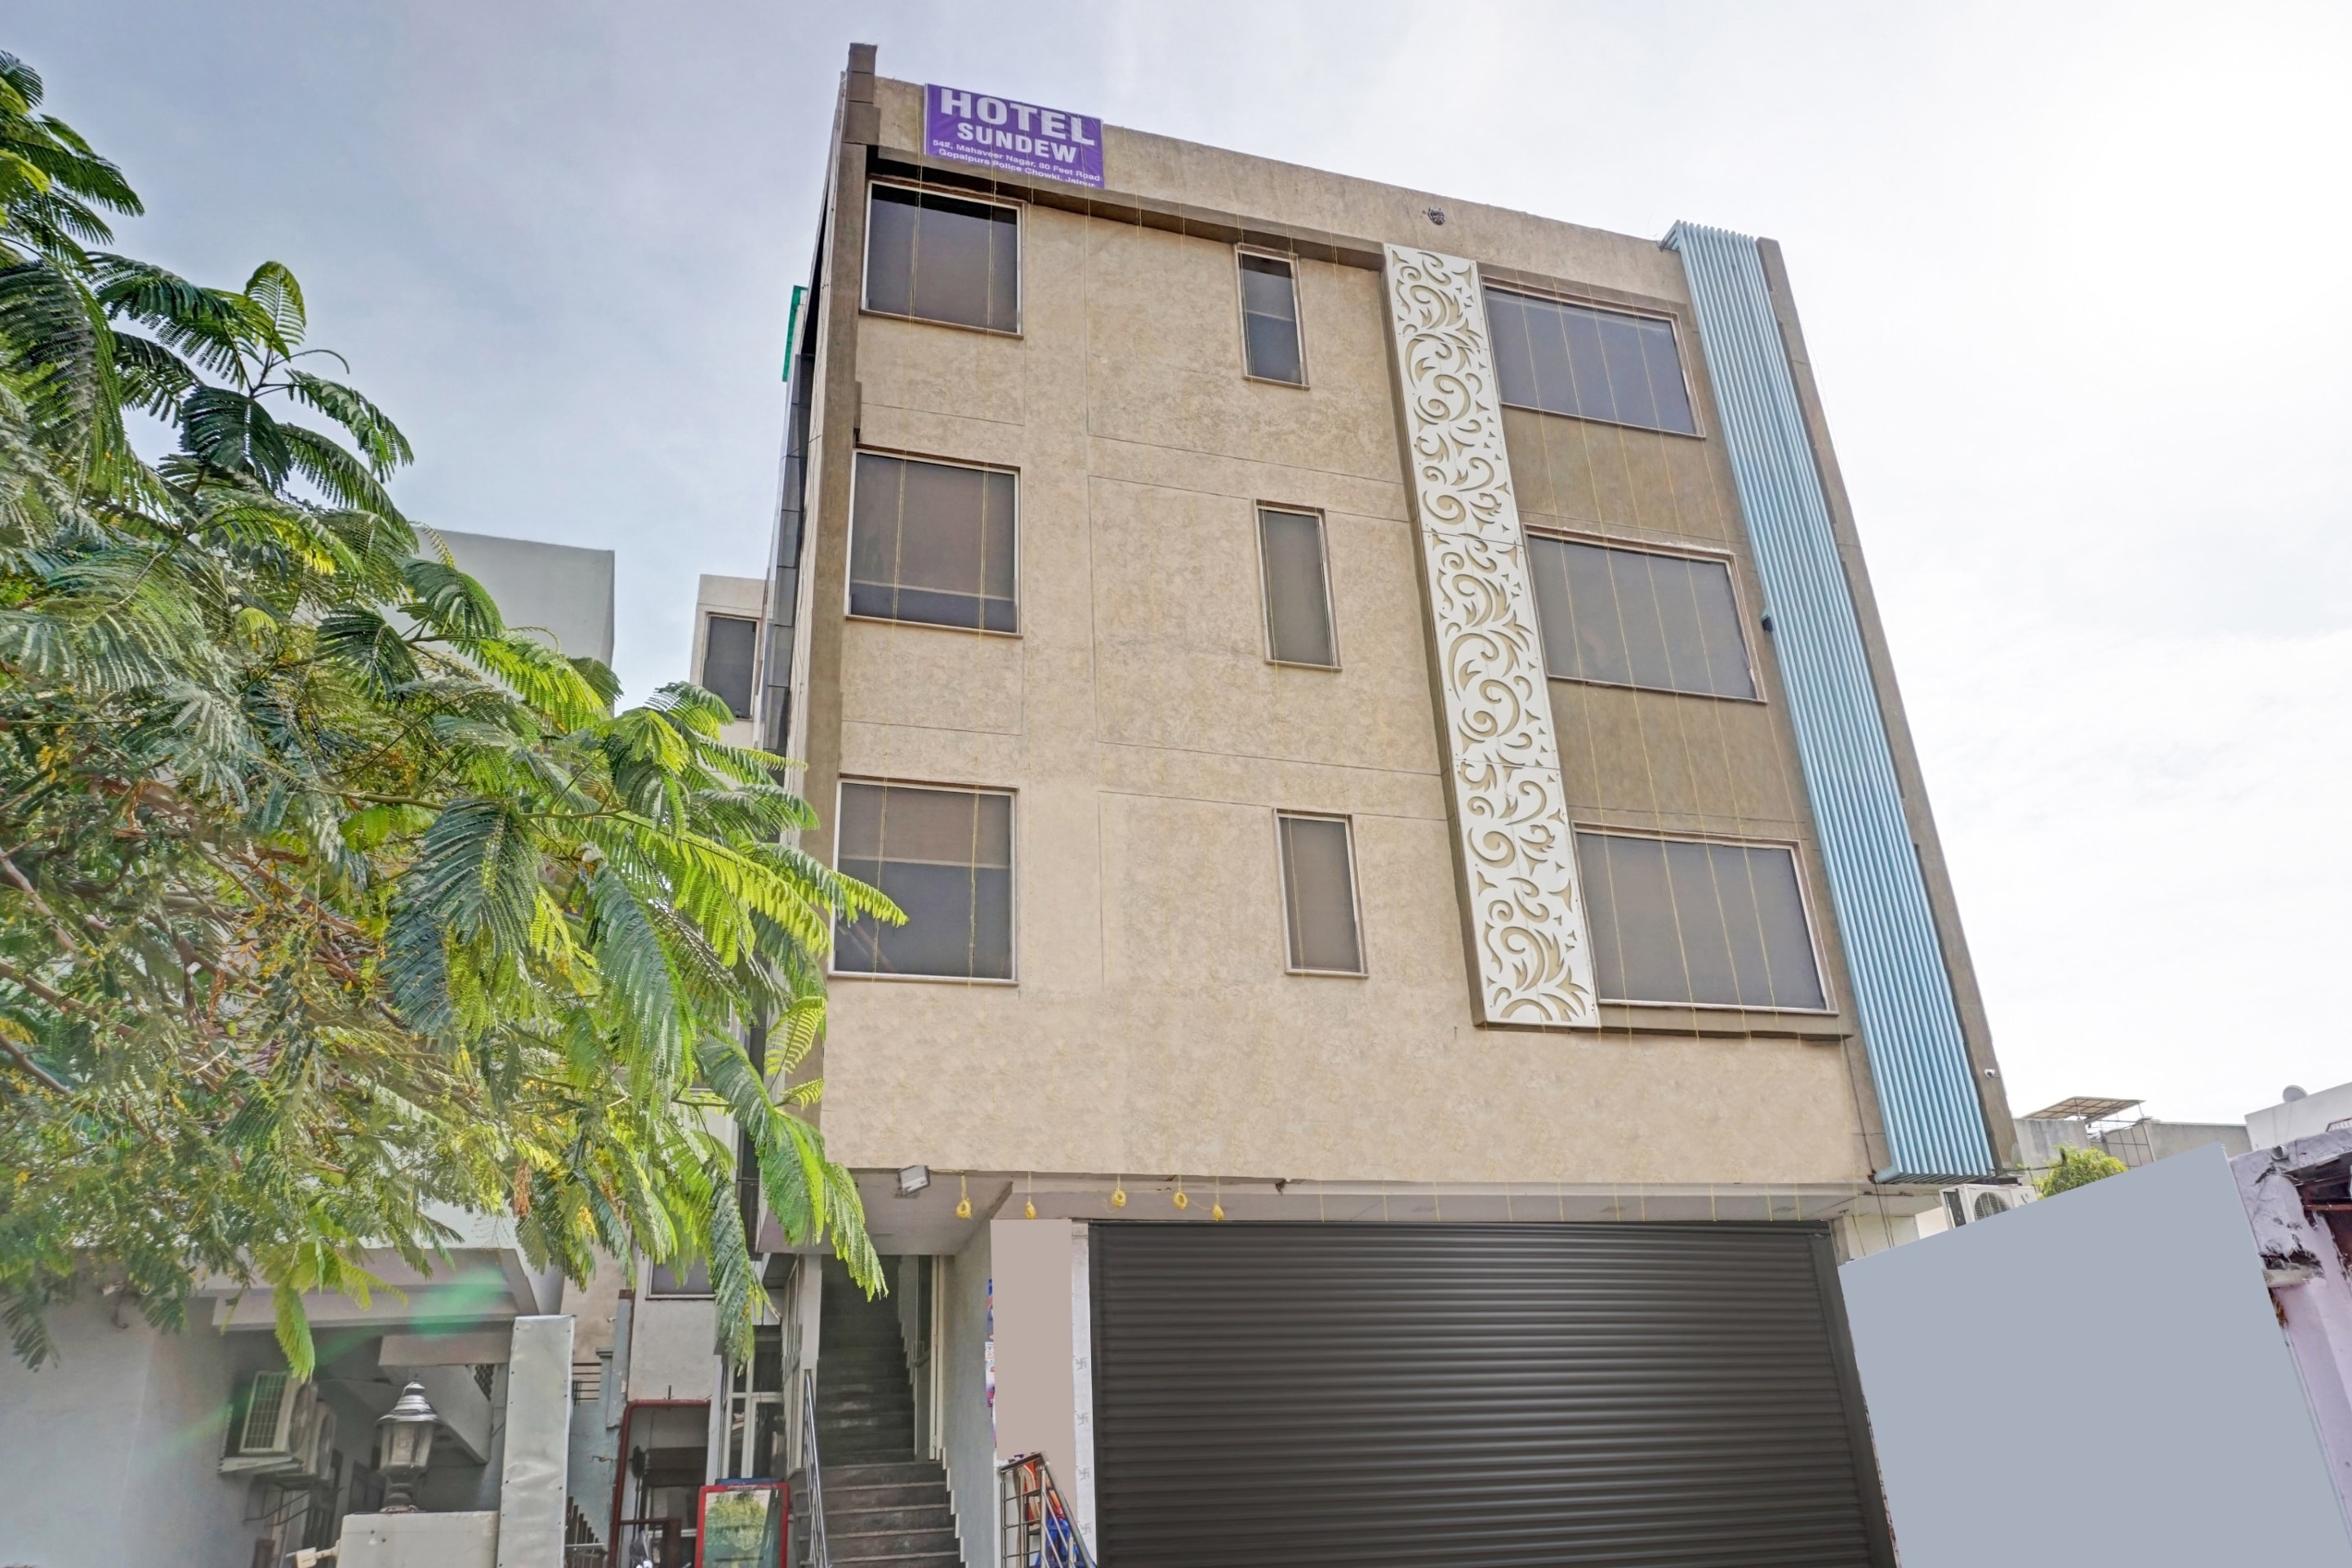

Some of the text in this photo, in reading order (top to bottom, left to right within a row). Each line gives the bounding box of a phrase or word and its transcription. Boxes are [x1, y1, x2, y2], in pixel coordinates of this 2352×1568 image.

[941, 88, 1095, 146] HOTEL
[938, 148, 990, 165] Gopalpura
[992, 159, 1022, 172] Police
[957, 122, 1076, 163] SUNDEW
[956, 144, 1004, 159] Mahaveer
[1038, 162, 1050, 170] 80
[1053, 165, 1073, 176] Feet
[1076, 170, 1100, 181] Road
